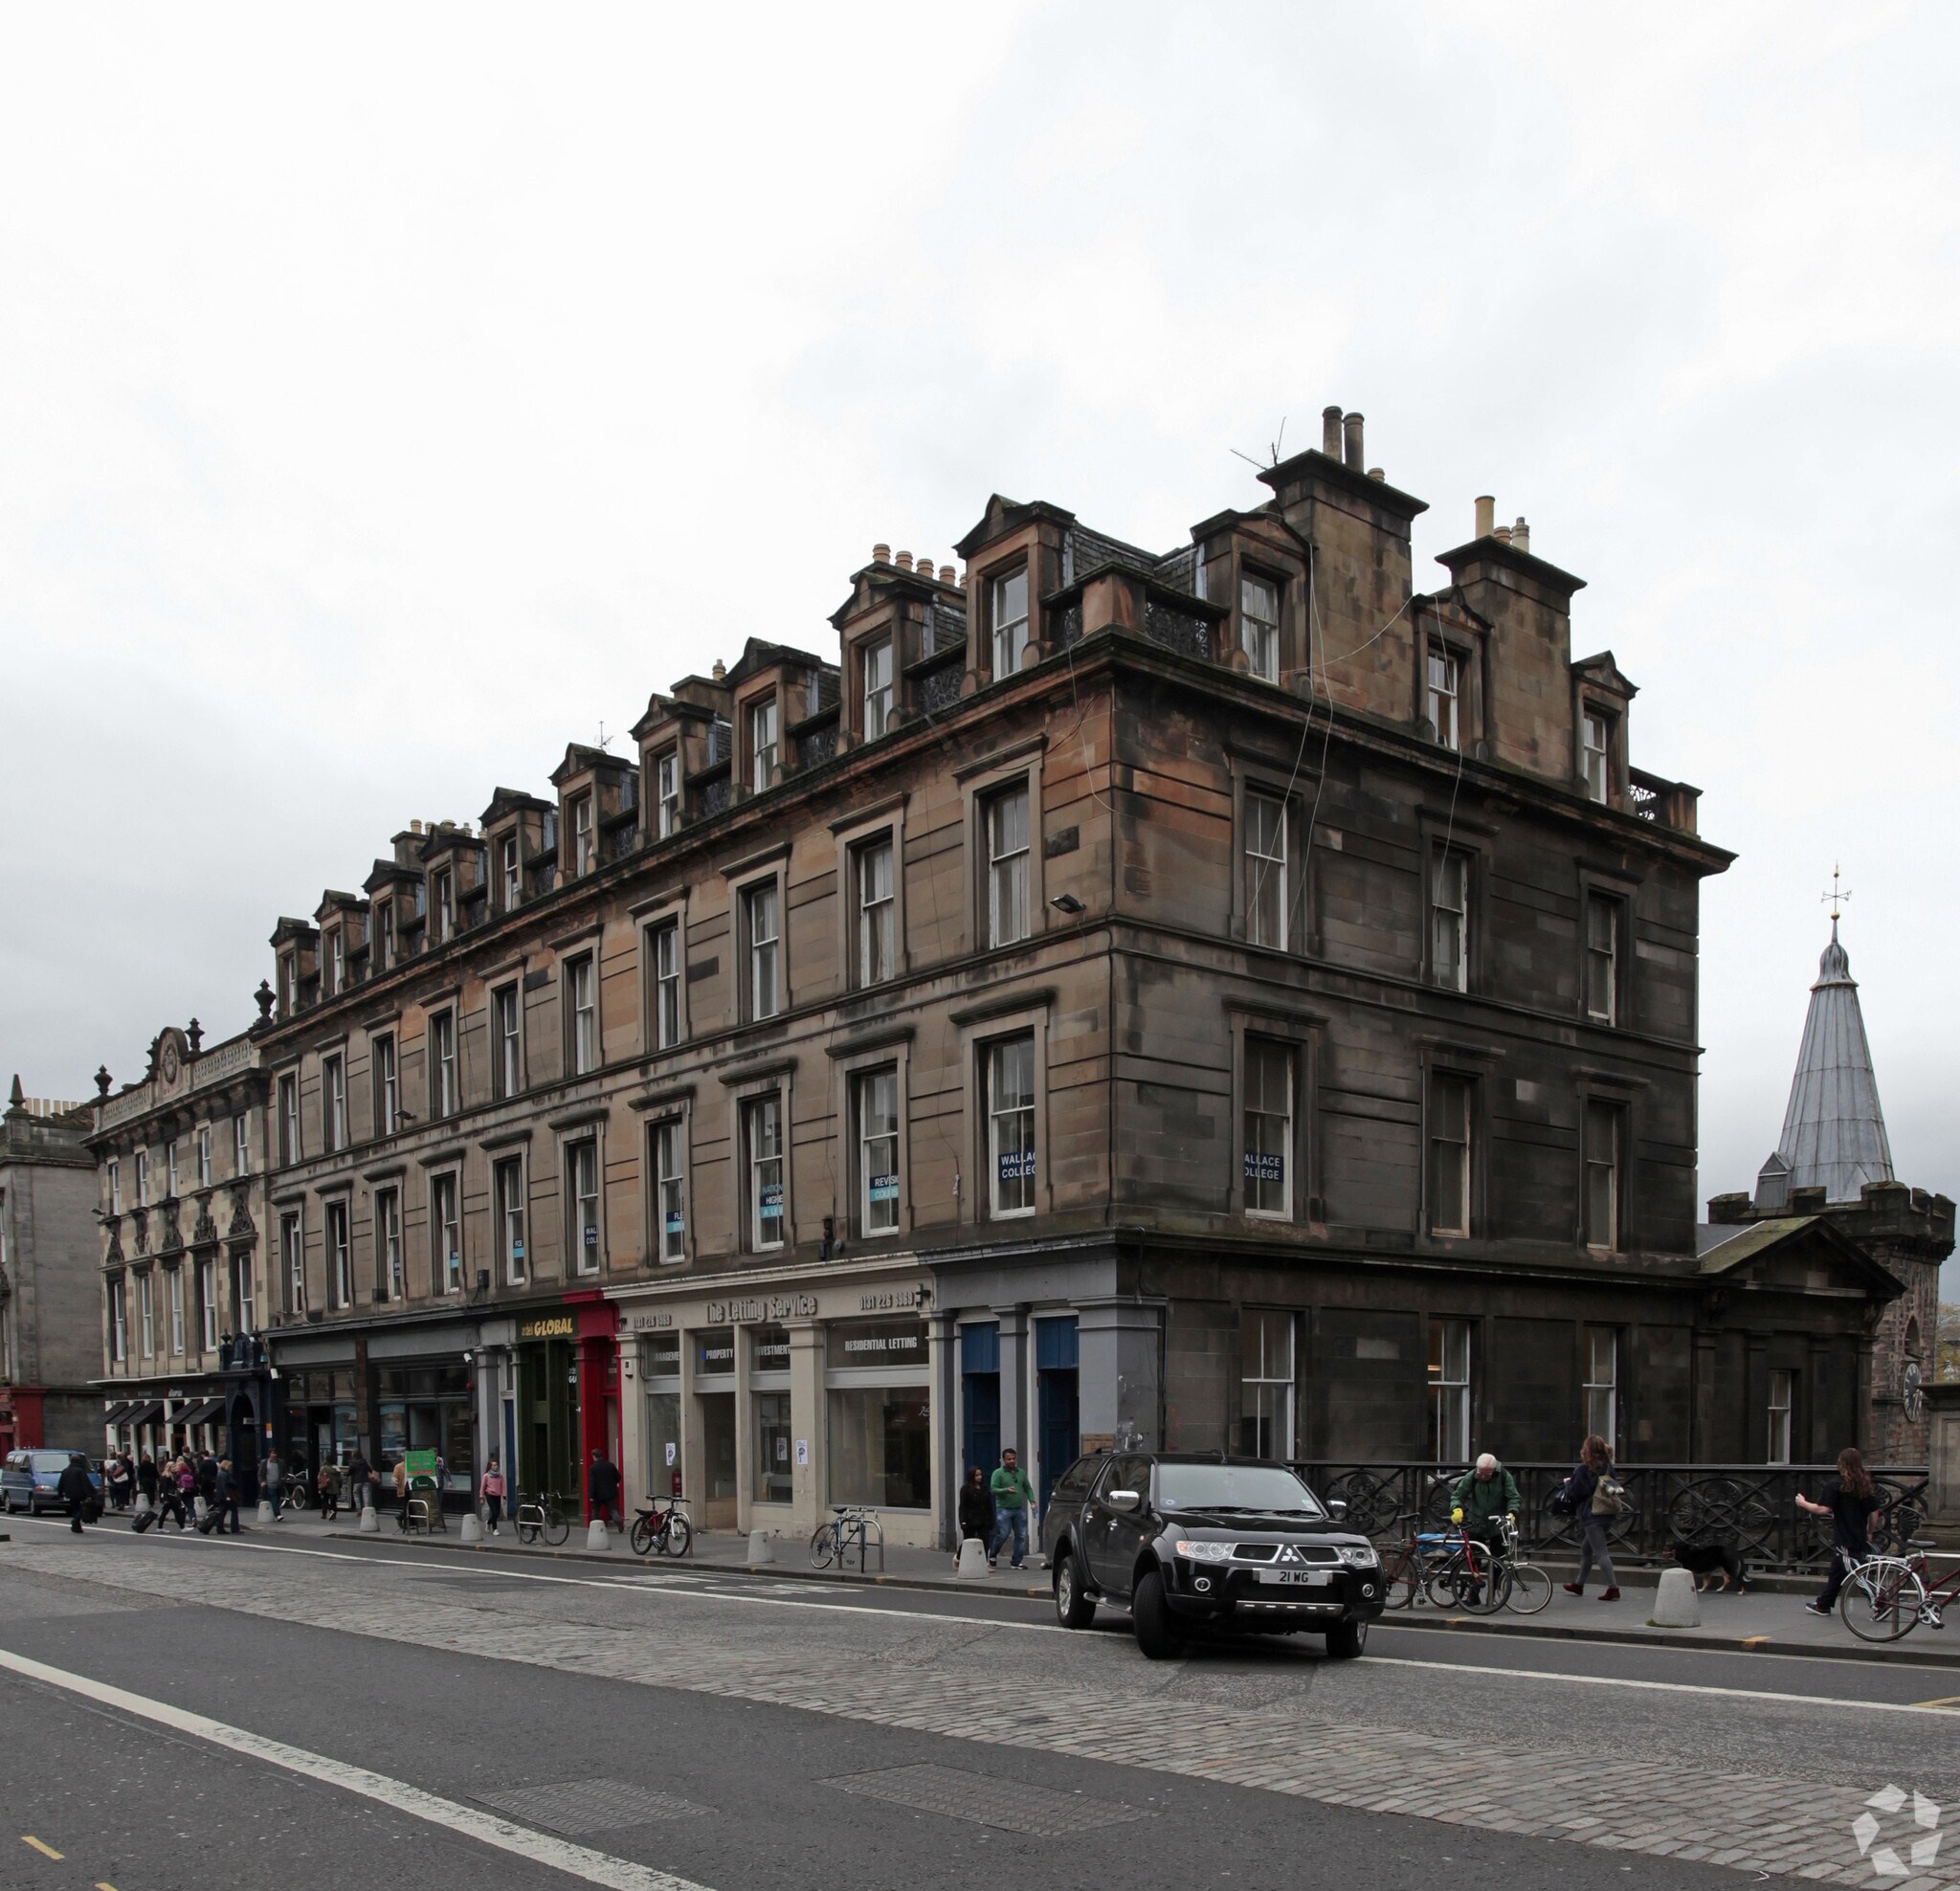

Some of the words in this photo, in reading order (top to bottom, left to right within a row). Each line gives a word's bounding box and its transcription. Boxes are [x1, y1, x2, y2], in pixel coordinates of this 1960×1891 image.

[1244, 1153, 1281, 1168] ALLACE
[1244, 1167, 1280, 1180] OLLEGE
[706, 1302, 725, 1324] The
[727, 1300, 767, 1322] Letting
[768, 1294, 817, 1319] Service
[534, 1318, 573, 1336] GLOBAL
[844, 1339, 887, 1352] RESIDENTIAL
[888, 1336, 918, 1350] LETTING
[705, 1347, 734, 1360] PROPERTY
[1280, 1571, 1291, 1583] 21
[1293, 1571, 1309, 1584] WG
